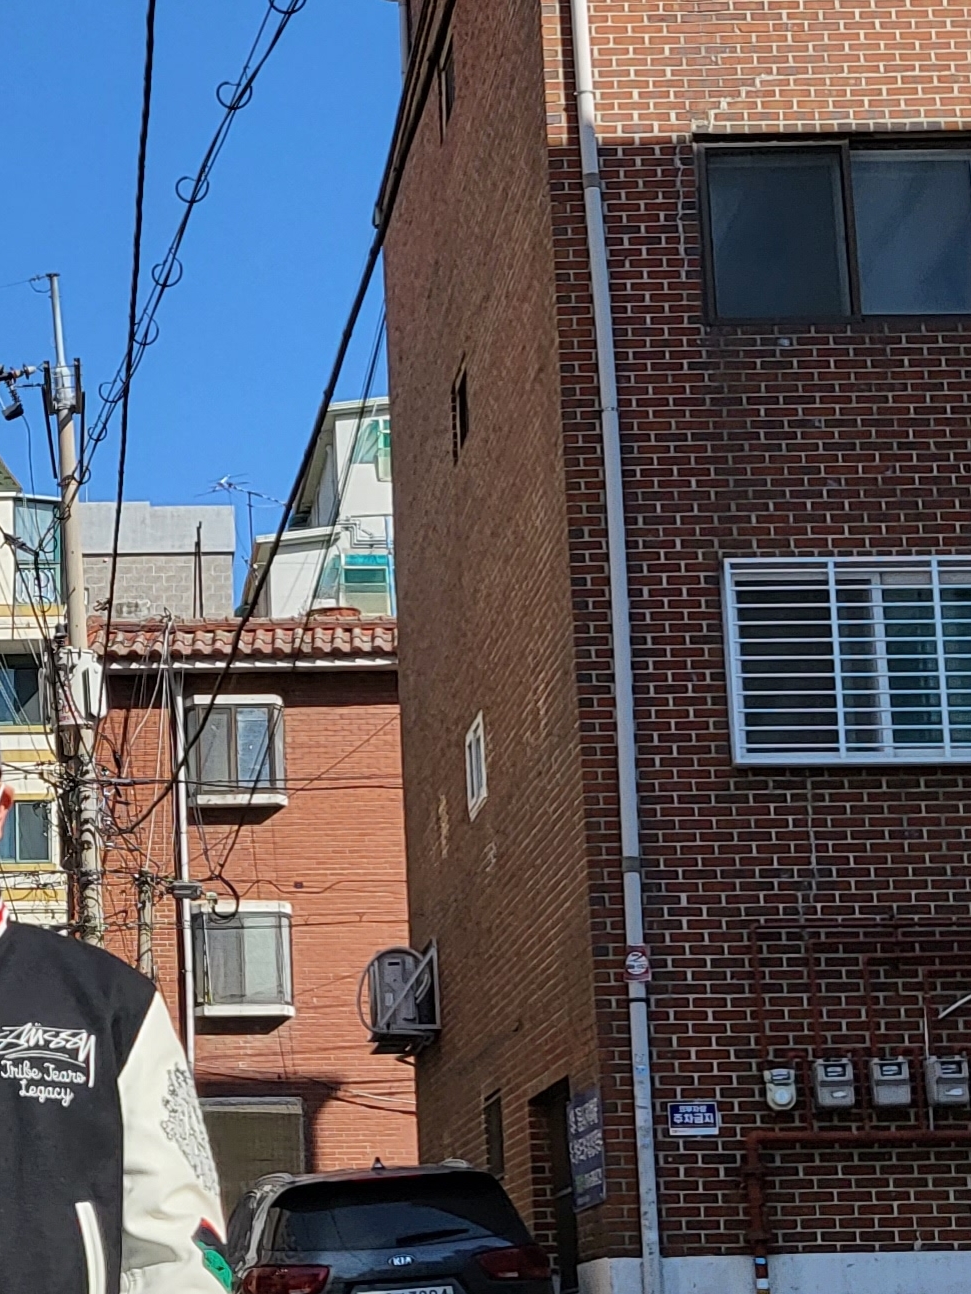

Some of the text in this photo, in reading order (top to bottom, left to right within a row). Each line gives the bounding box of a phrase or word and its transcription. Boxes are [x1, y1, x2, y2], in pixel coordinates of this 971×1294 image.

[0, 1060, 42, 1079] Tribe
[18, 1079, 74, 1107] Legacy
[673, 1113, 714, 1124] 주차금지
[392, 1256, 412, 1266] KIA
